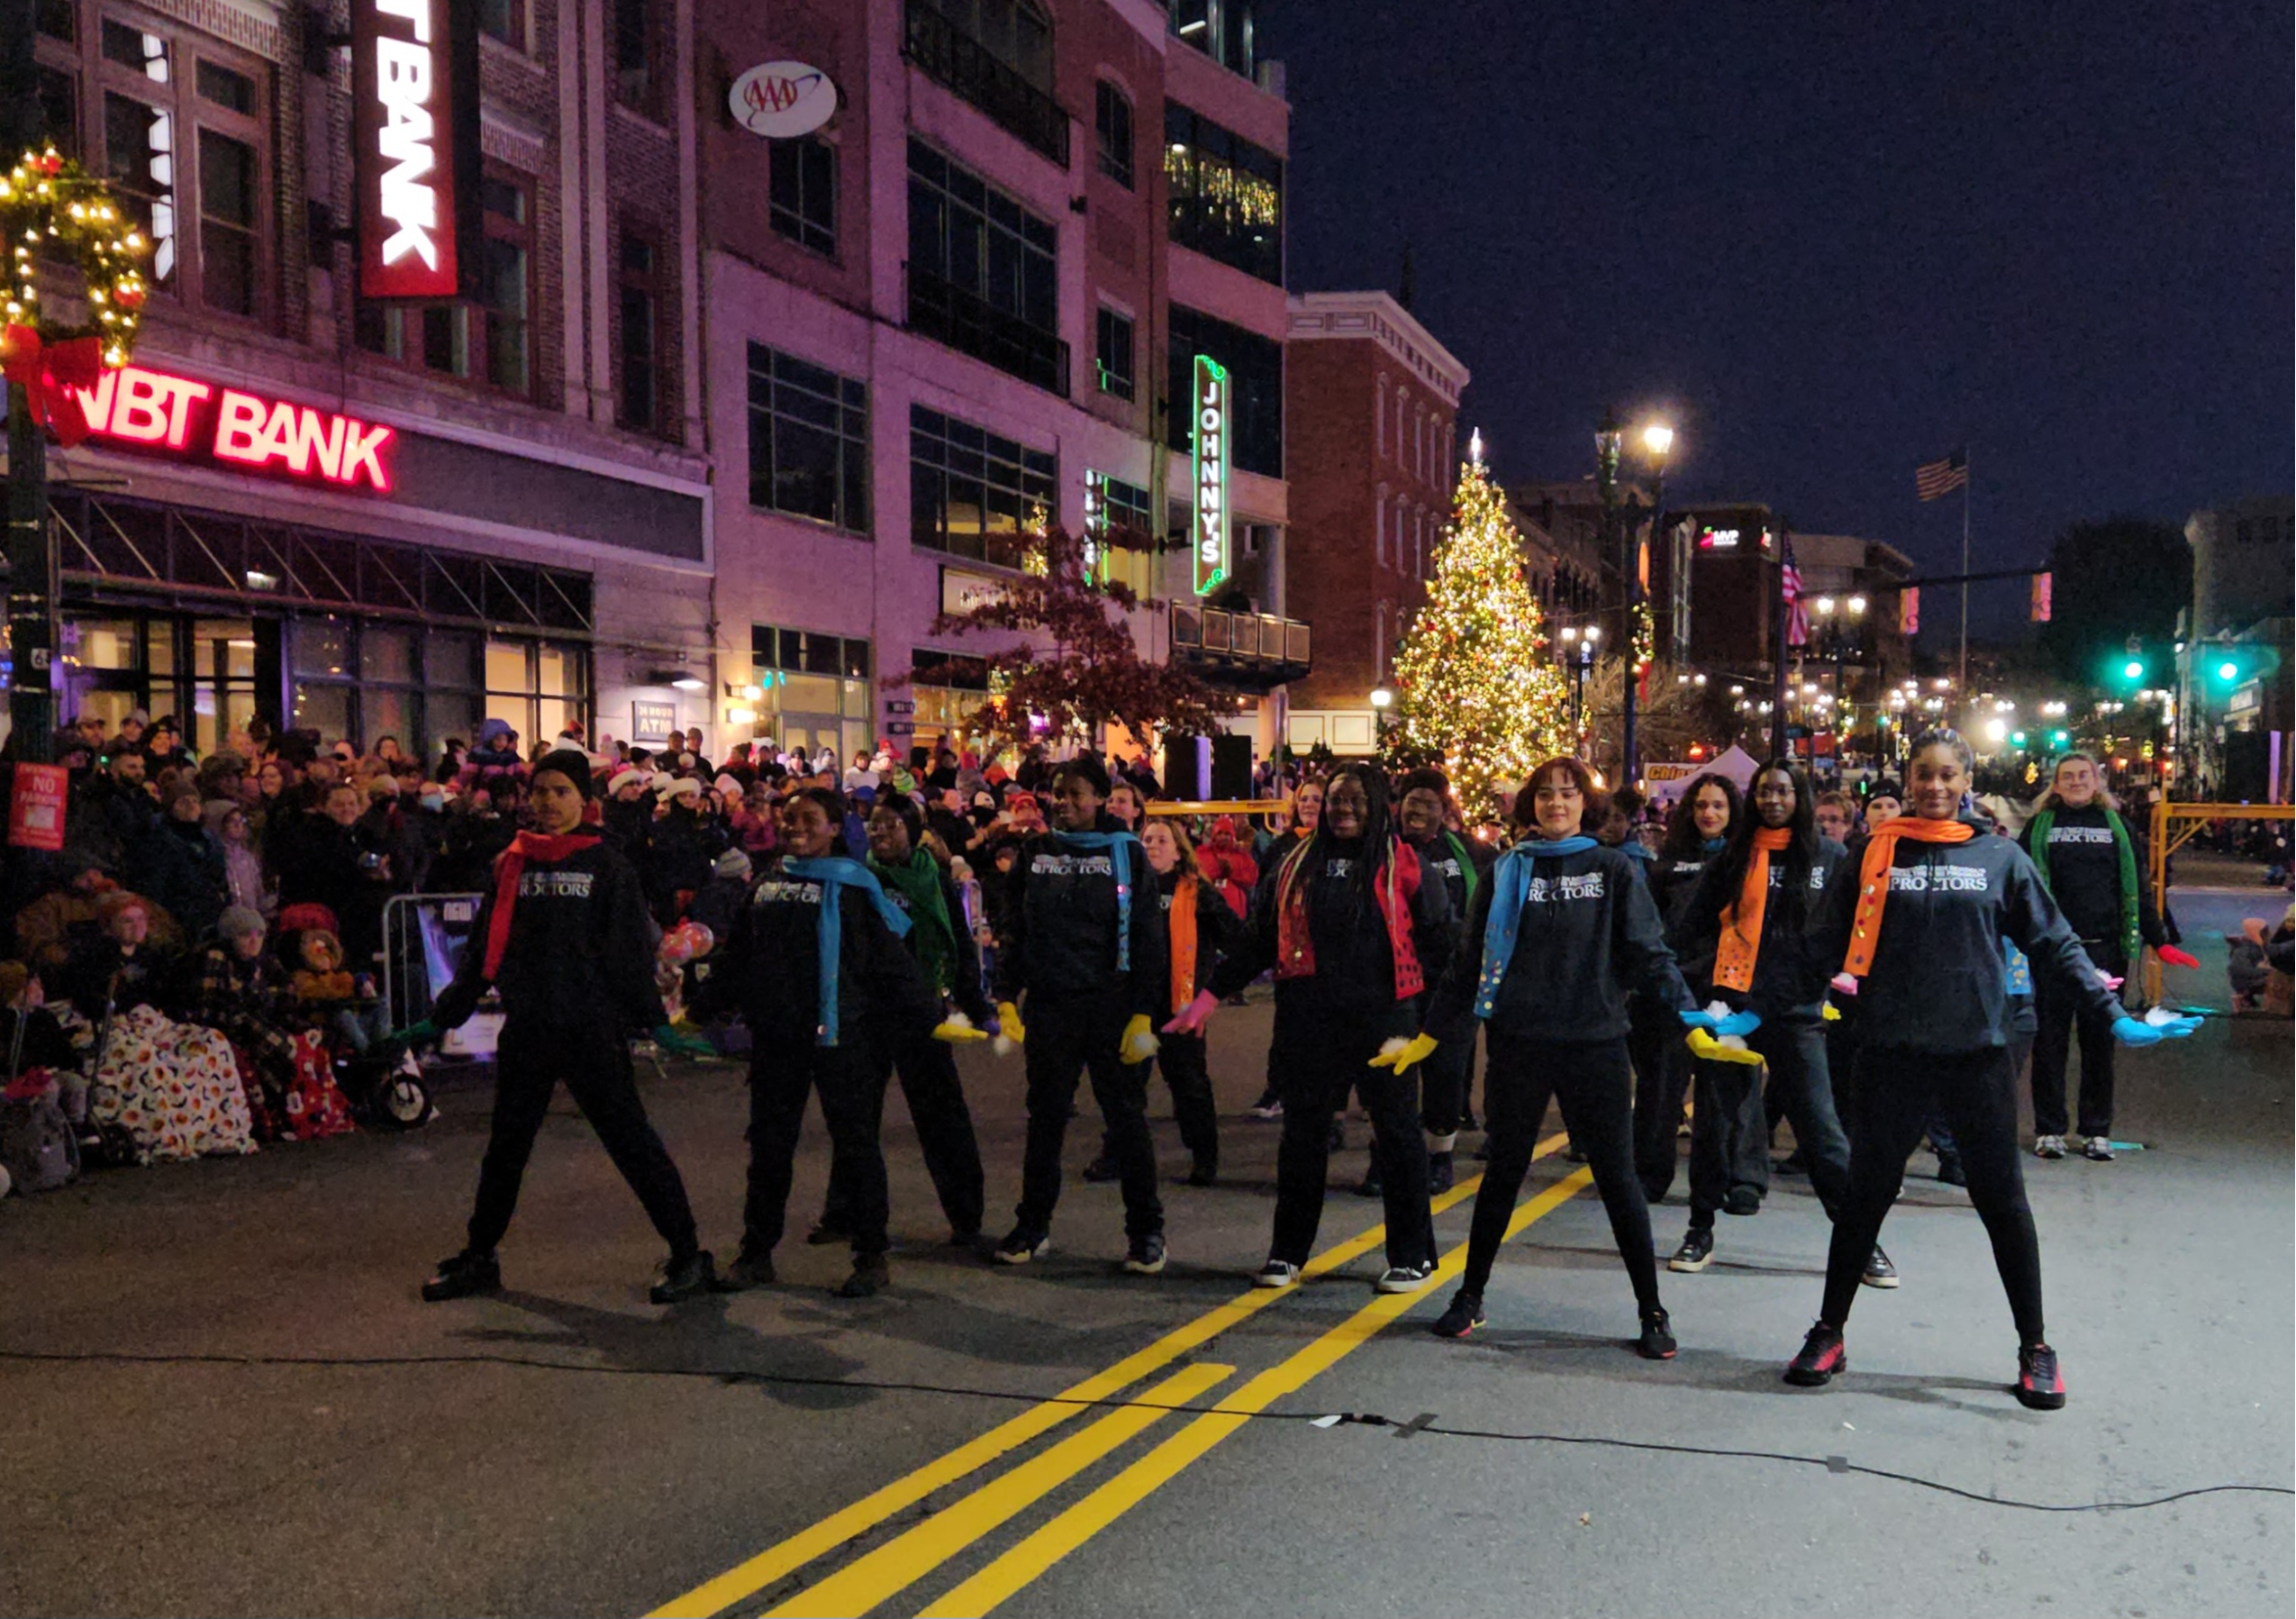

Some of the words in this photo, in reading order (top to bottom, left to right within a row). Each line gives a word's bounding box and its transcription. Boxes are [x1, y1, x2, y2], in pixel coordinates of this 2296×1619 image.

[747, 75, 796, 113] AAA
[377, 36, 436, 272] BANK
[213, 387, 394, 492] BANK
[1200, 380, 1221, 564] JOHNNY'S
[1713, 530, 1739, 541] MVP
[649, 706, 674, 718] HOUR
[640, 718, 673, 734] ATM
[33, 777, 55, 793] NO
[520, 883, 591, 897] ROCTORS
[1529, 885, 1604, 902] ROCTORS
